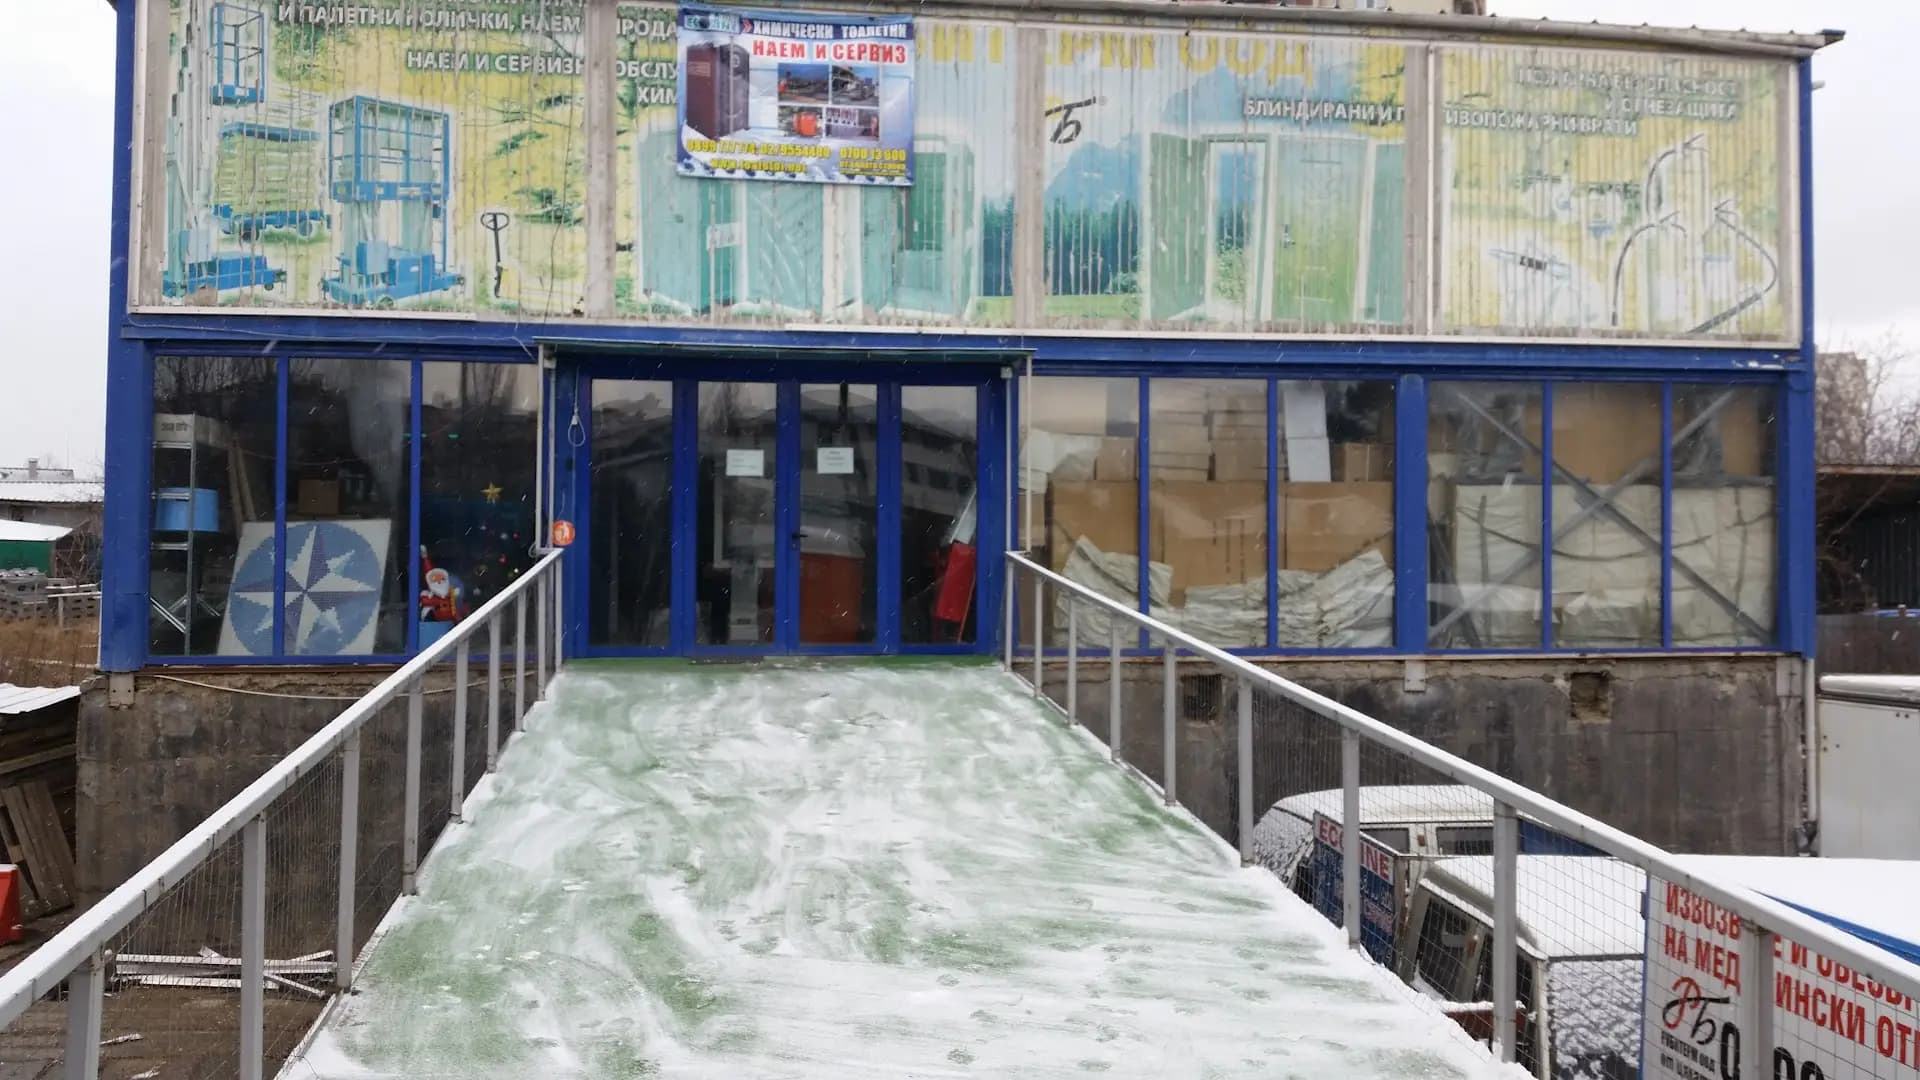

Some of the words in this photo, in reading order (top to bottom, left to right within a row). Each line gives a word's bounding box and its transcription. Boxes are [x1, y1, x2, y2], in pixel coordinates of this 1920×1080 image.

[753, 20, 834, 39] ХИМИЧЕСКИ
[753, 40, 804, 57] НАЕМ
[816, 44, 827, 59] И
[833, 43, 906, 63] СЕРВИЗ
[1664, 924, 1688, 964] НА
